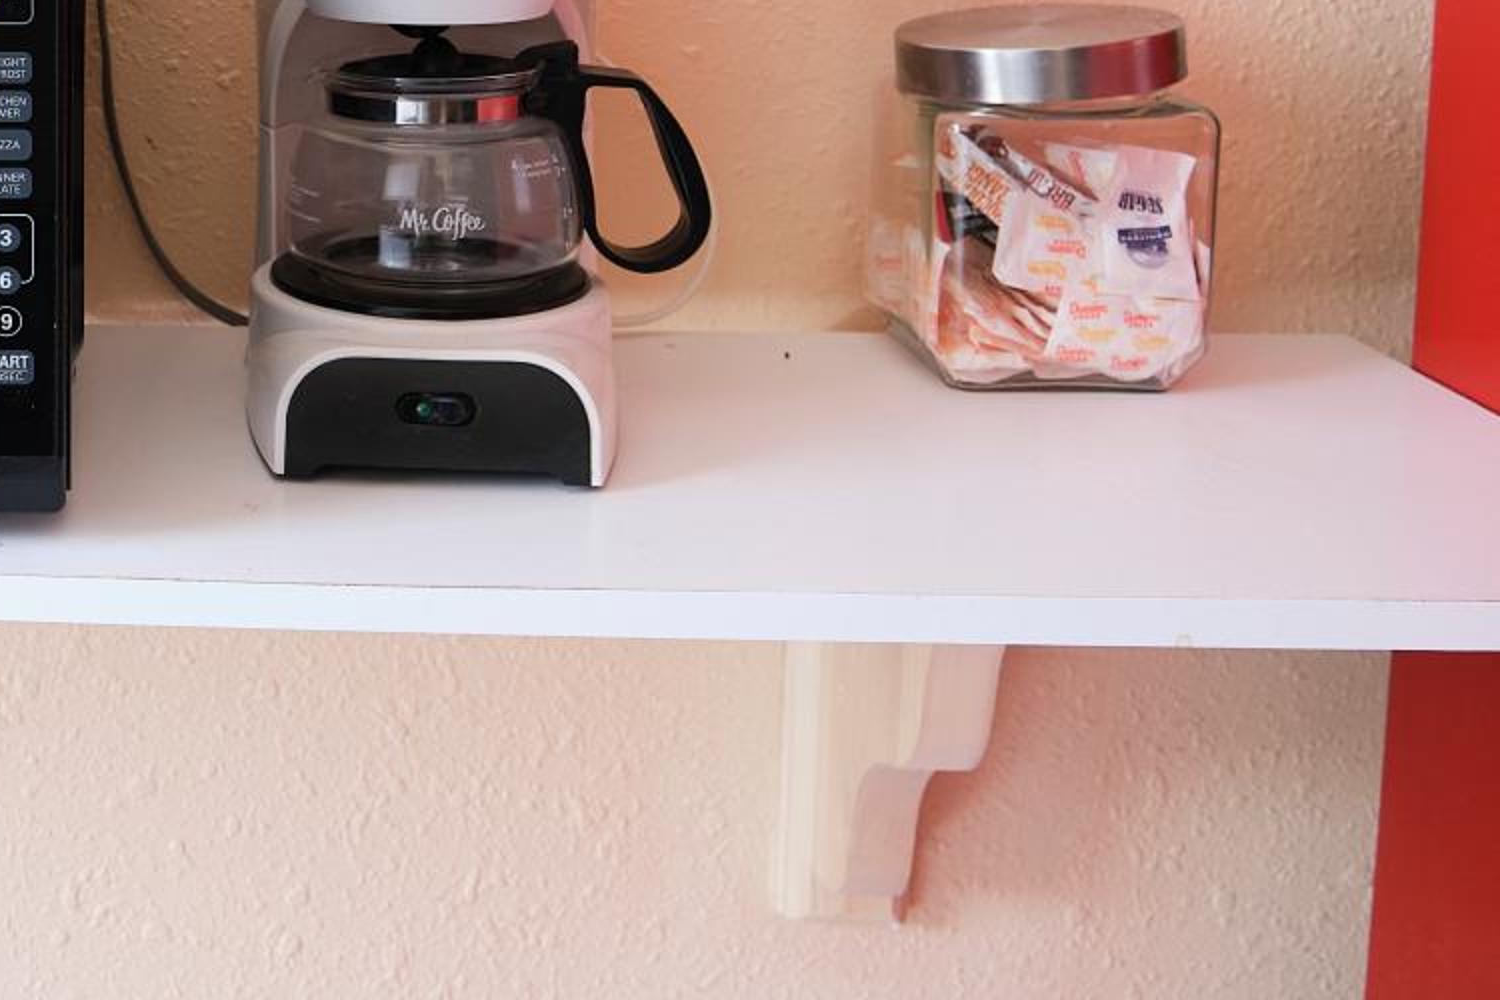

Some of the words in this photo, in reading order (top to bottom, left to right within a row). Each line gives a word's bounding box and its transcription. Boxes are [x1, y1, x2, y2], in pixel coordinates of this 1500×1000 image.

[432, 206, 486, 241] Coffee
[0, 229, 13, 247] 3
[0, 271, 12, 289] 6
[0, 313, 13, 331] 9
